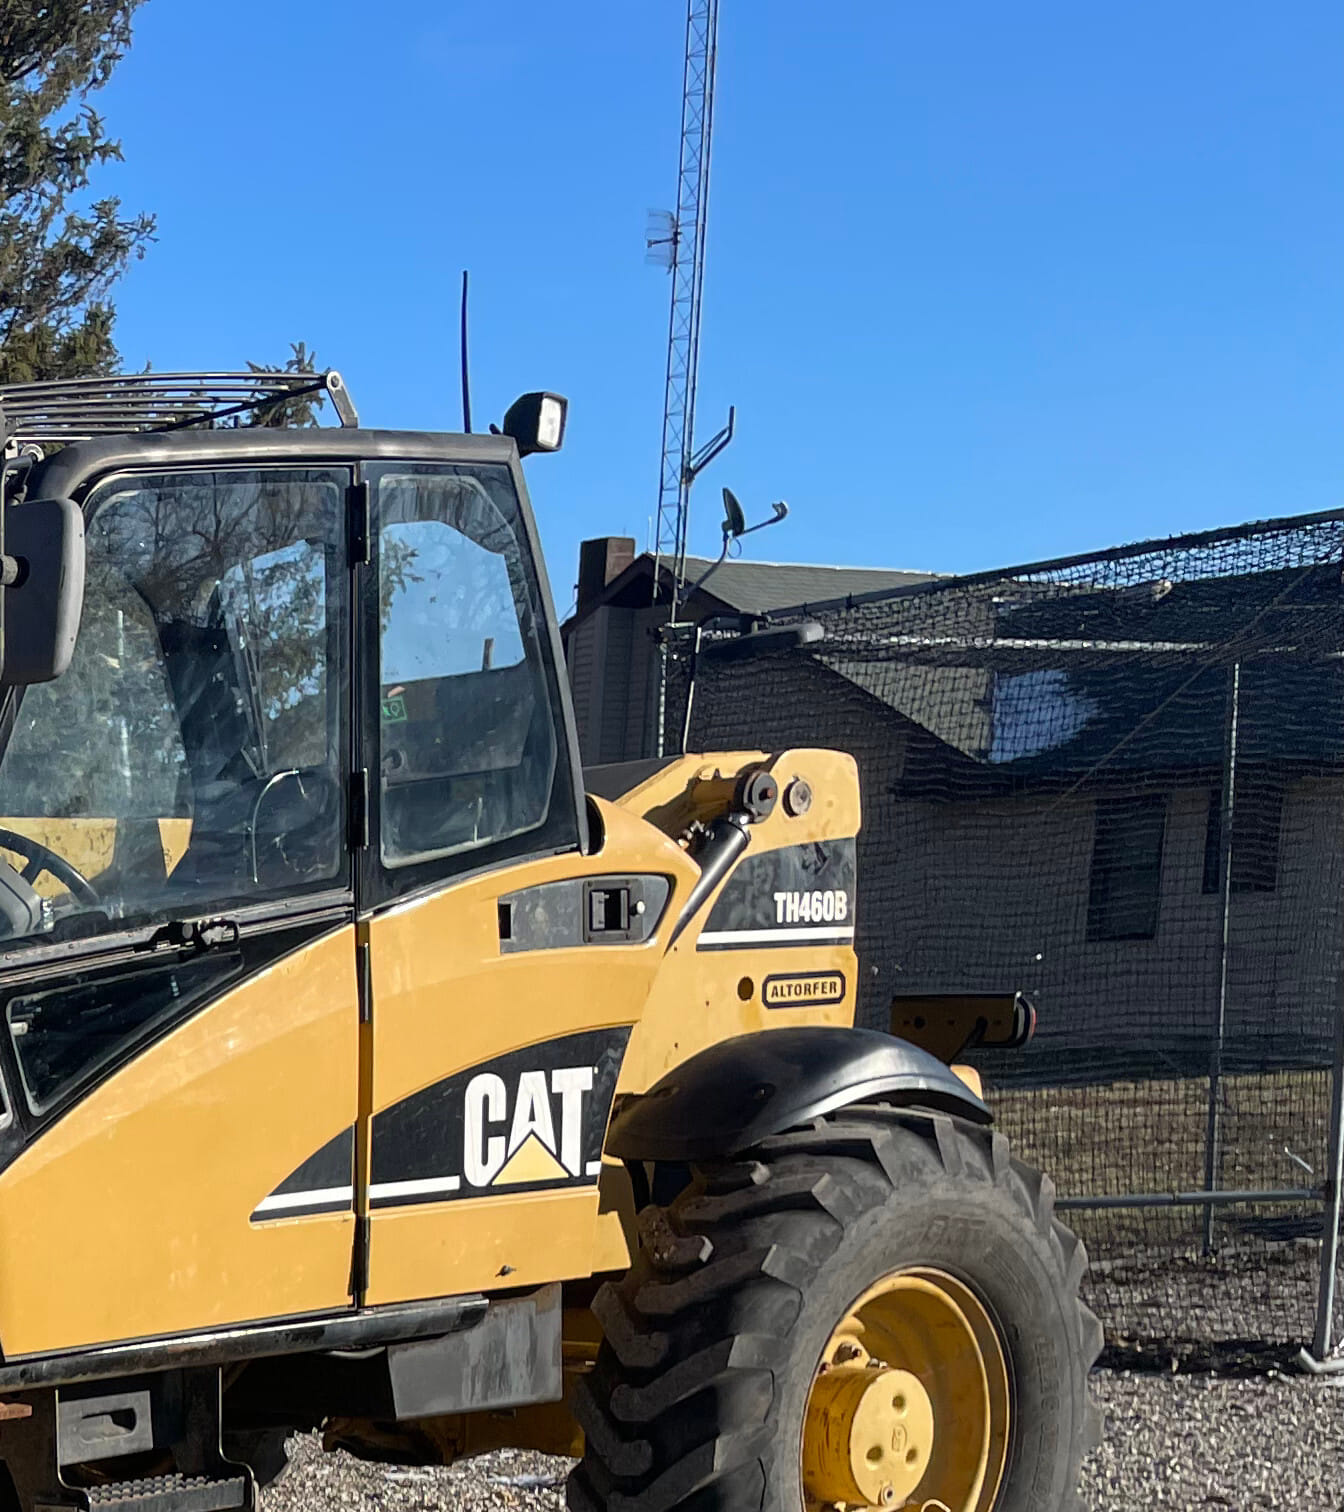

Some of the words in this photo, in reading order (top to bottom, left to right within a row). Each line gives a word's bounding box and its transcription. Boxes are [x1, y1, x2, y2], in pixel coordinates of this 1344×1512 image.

[774, 890, 847, 924] TH460B
[770, 979, 838, 998] ALTORFER
[463, 1065, 593, 1188] CAT
